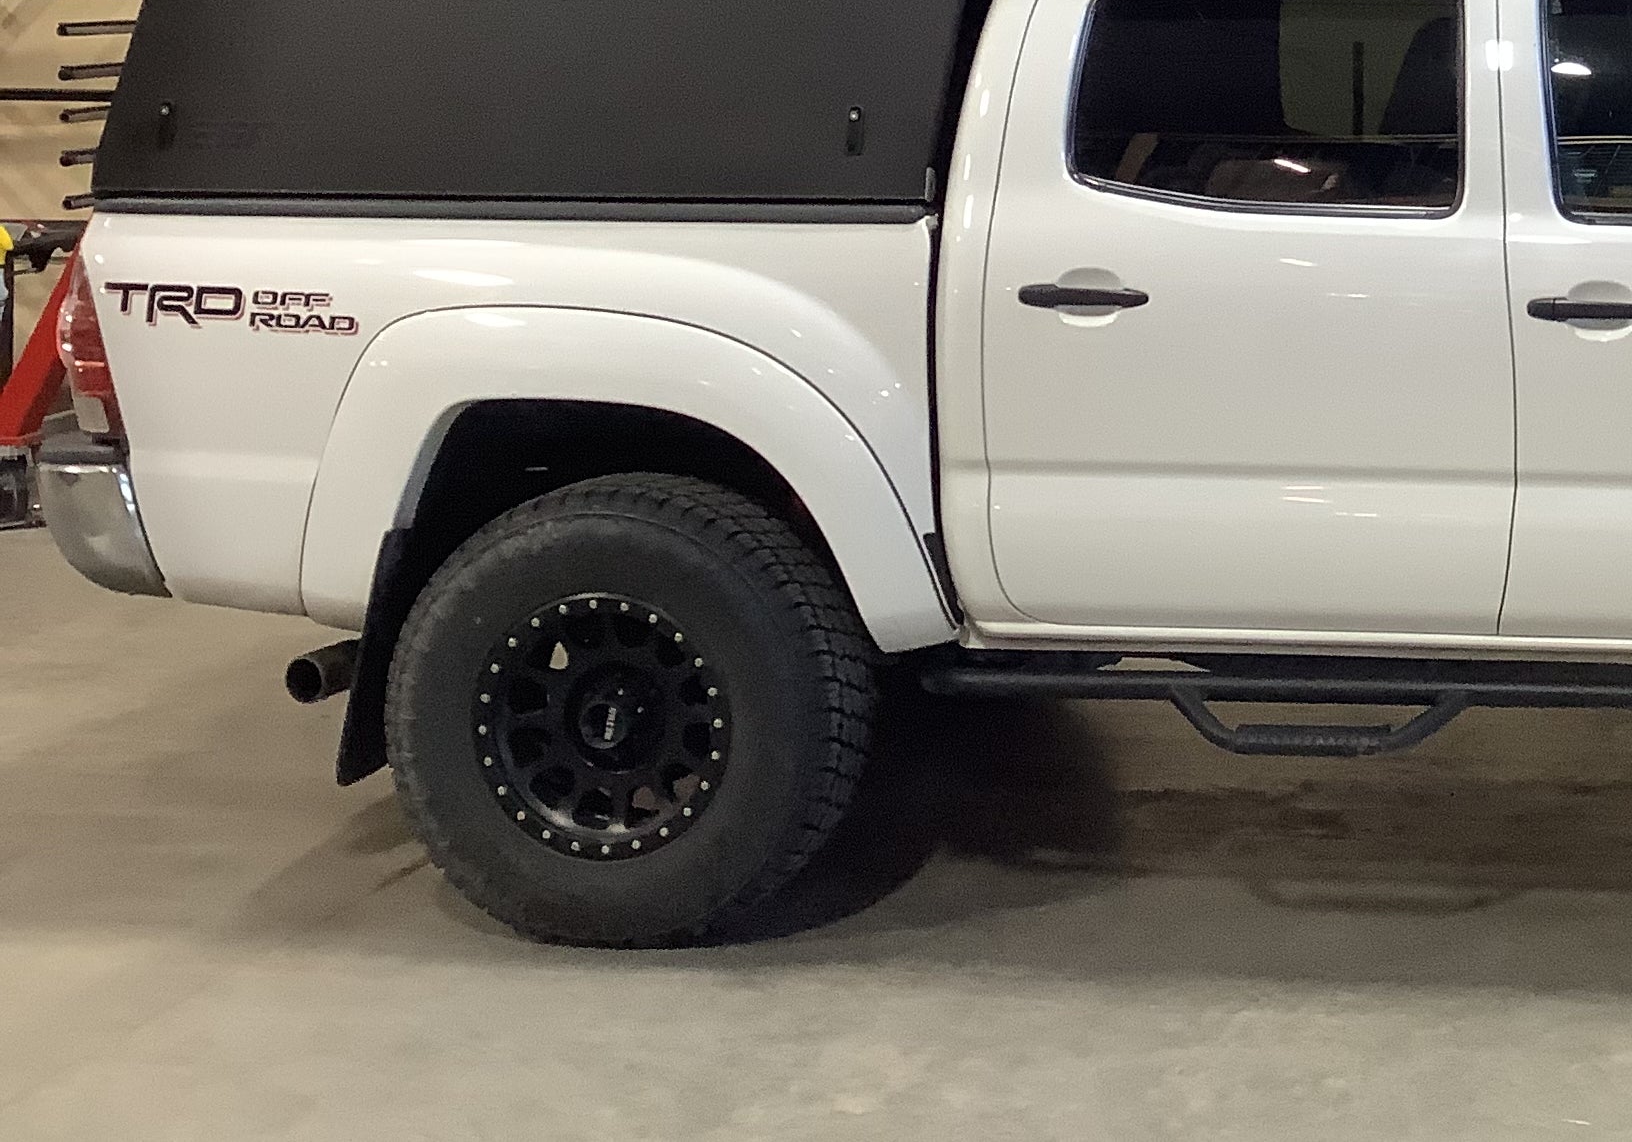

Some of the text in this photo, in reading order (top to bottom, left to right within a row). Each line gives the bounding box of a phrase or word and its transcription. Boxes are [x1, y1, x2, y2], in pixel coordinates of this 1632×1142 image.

[104, 281, 244, 327] TRD
[251, 290, 332, 308] OFF
[249, 311, 357, 334] ROAD
